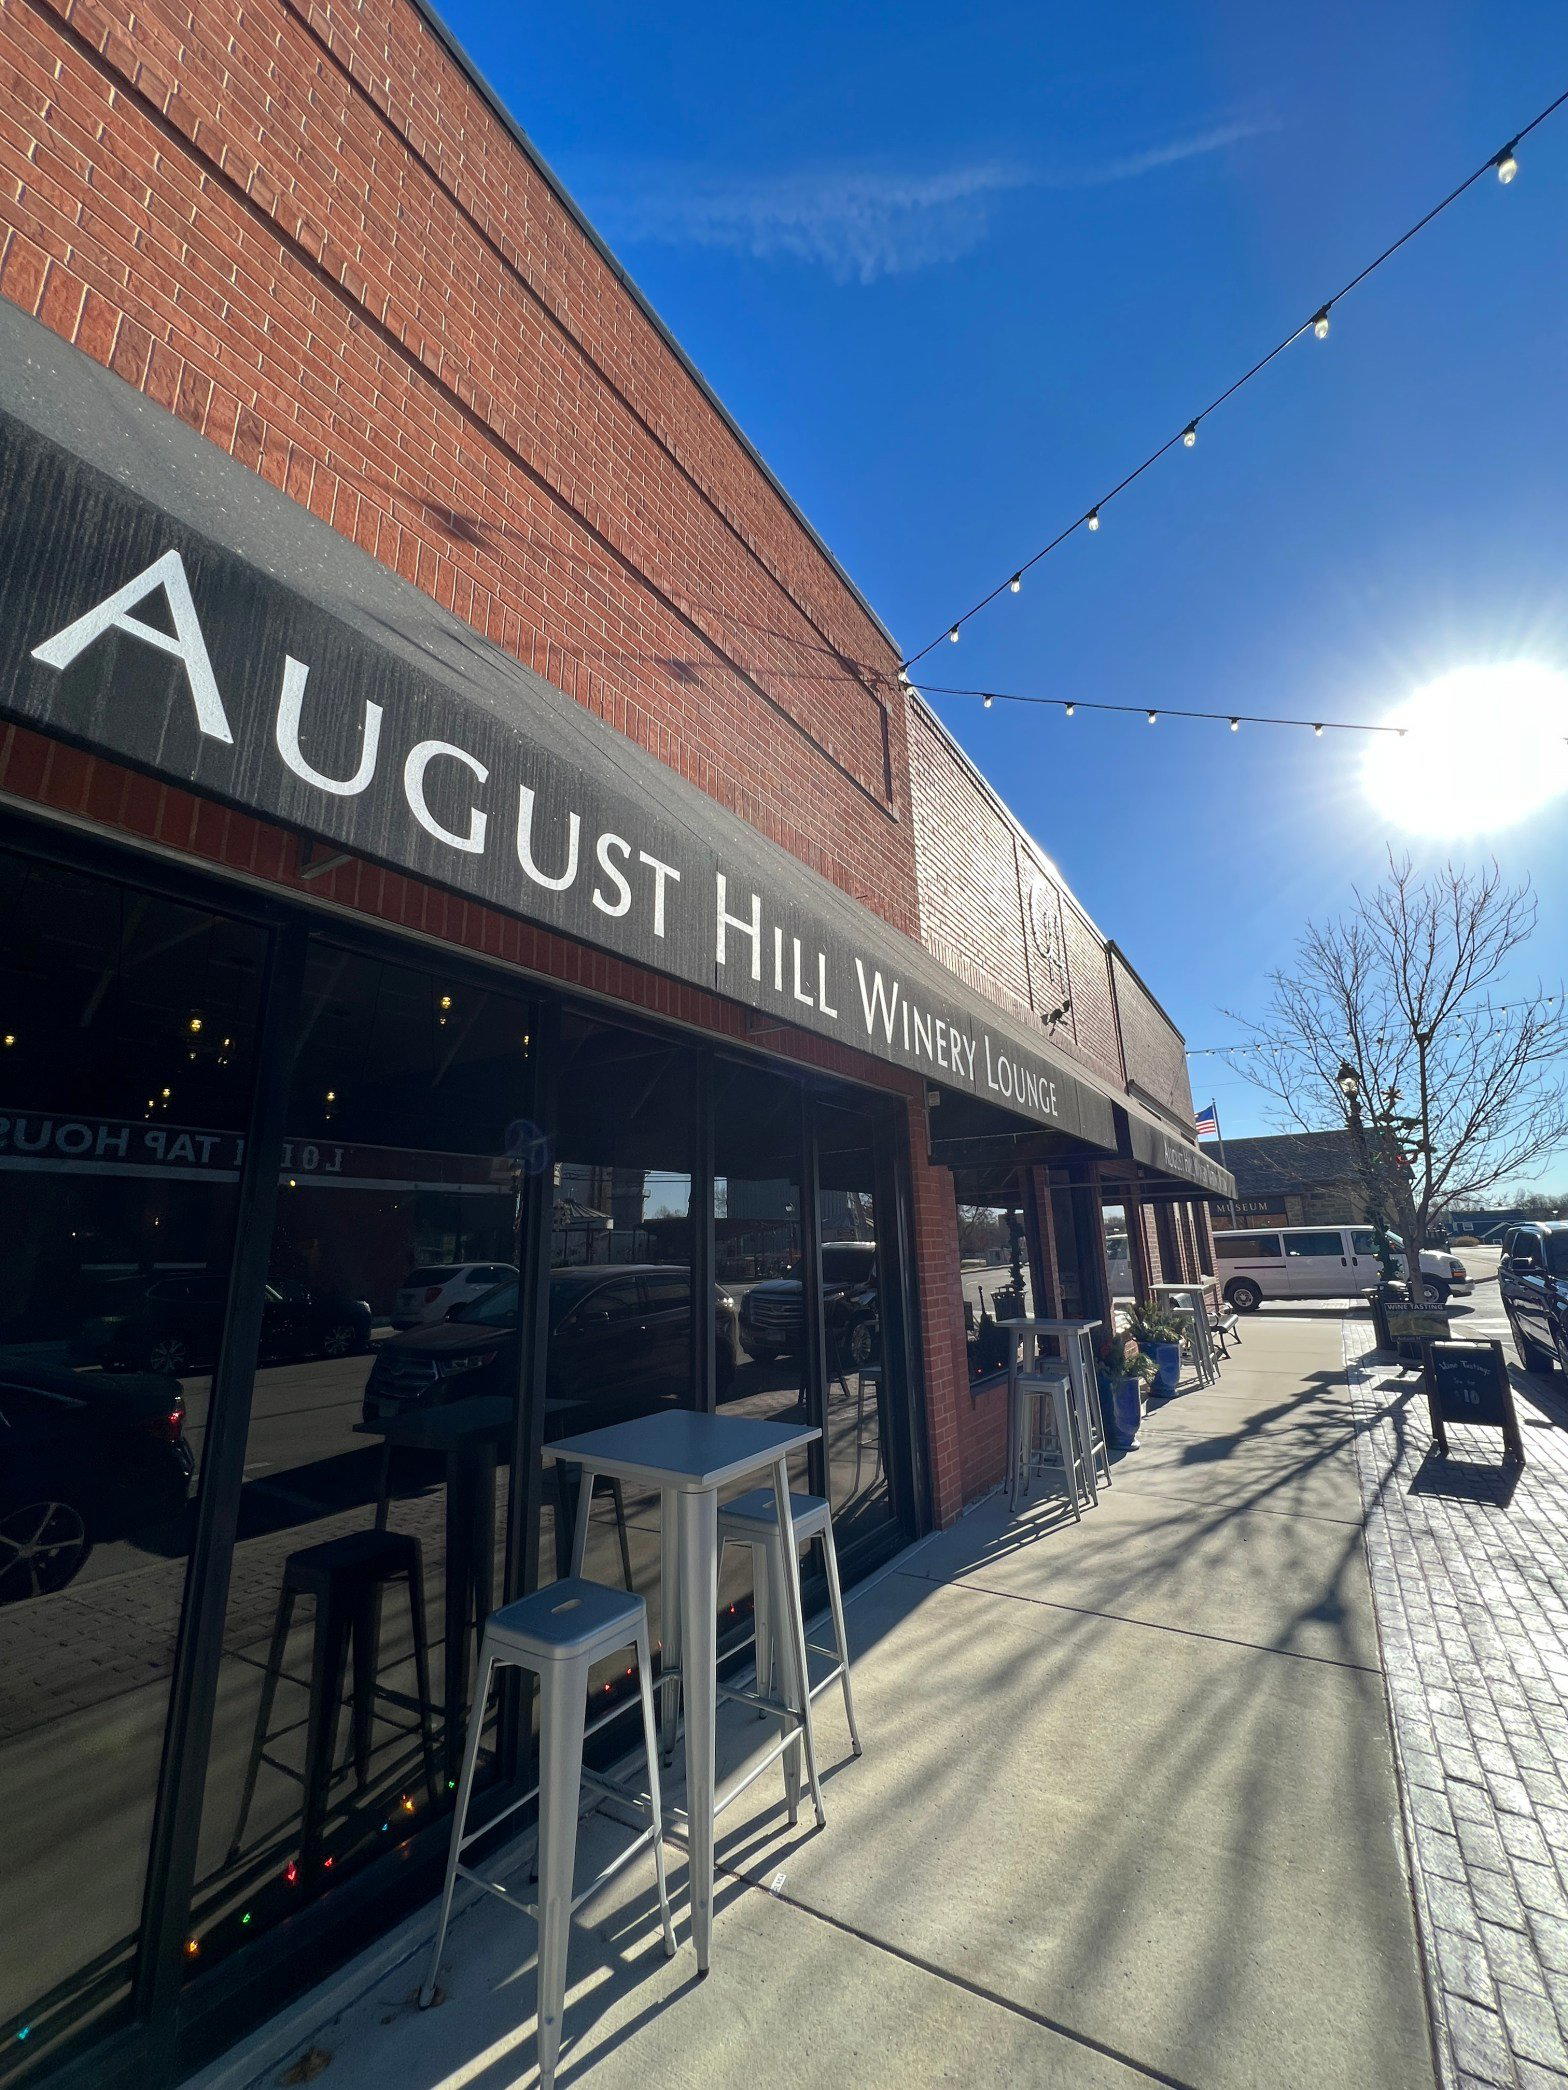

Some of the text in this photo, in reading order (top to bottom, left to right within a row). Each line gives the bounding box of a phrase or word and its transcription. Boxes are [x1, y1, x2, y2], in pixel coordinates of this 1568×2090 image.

[31, 549, 1059, 1117] AUGUST HILL WINERY LOUNGE
[1216, 1202, 1269, 1213] MUSEUM
